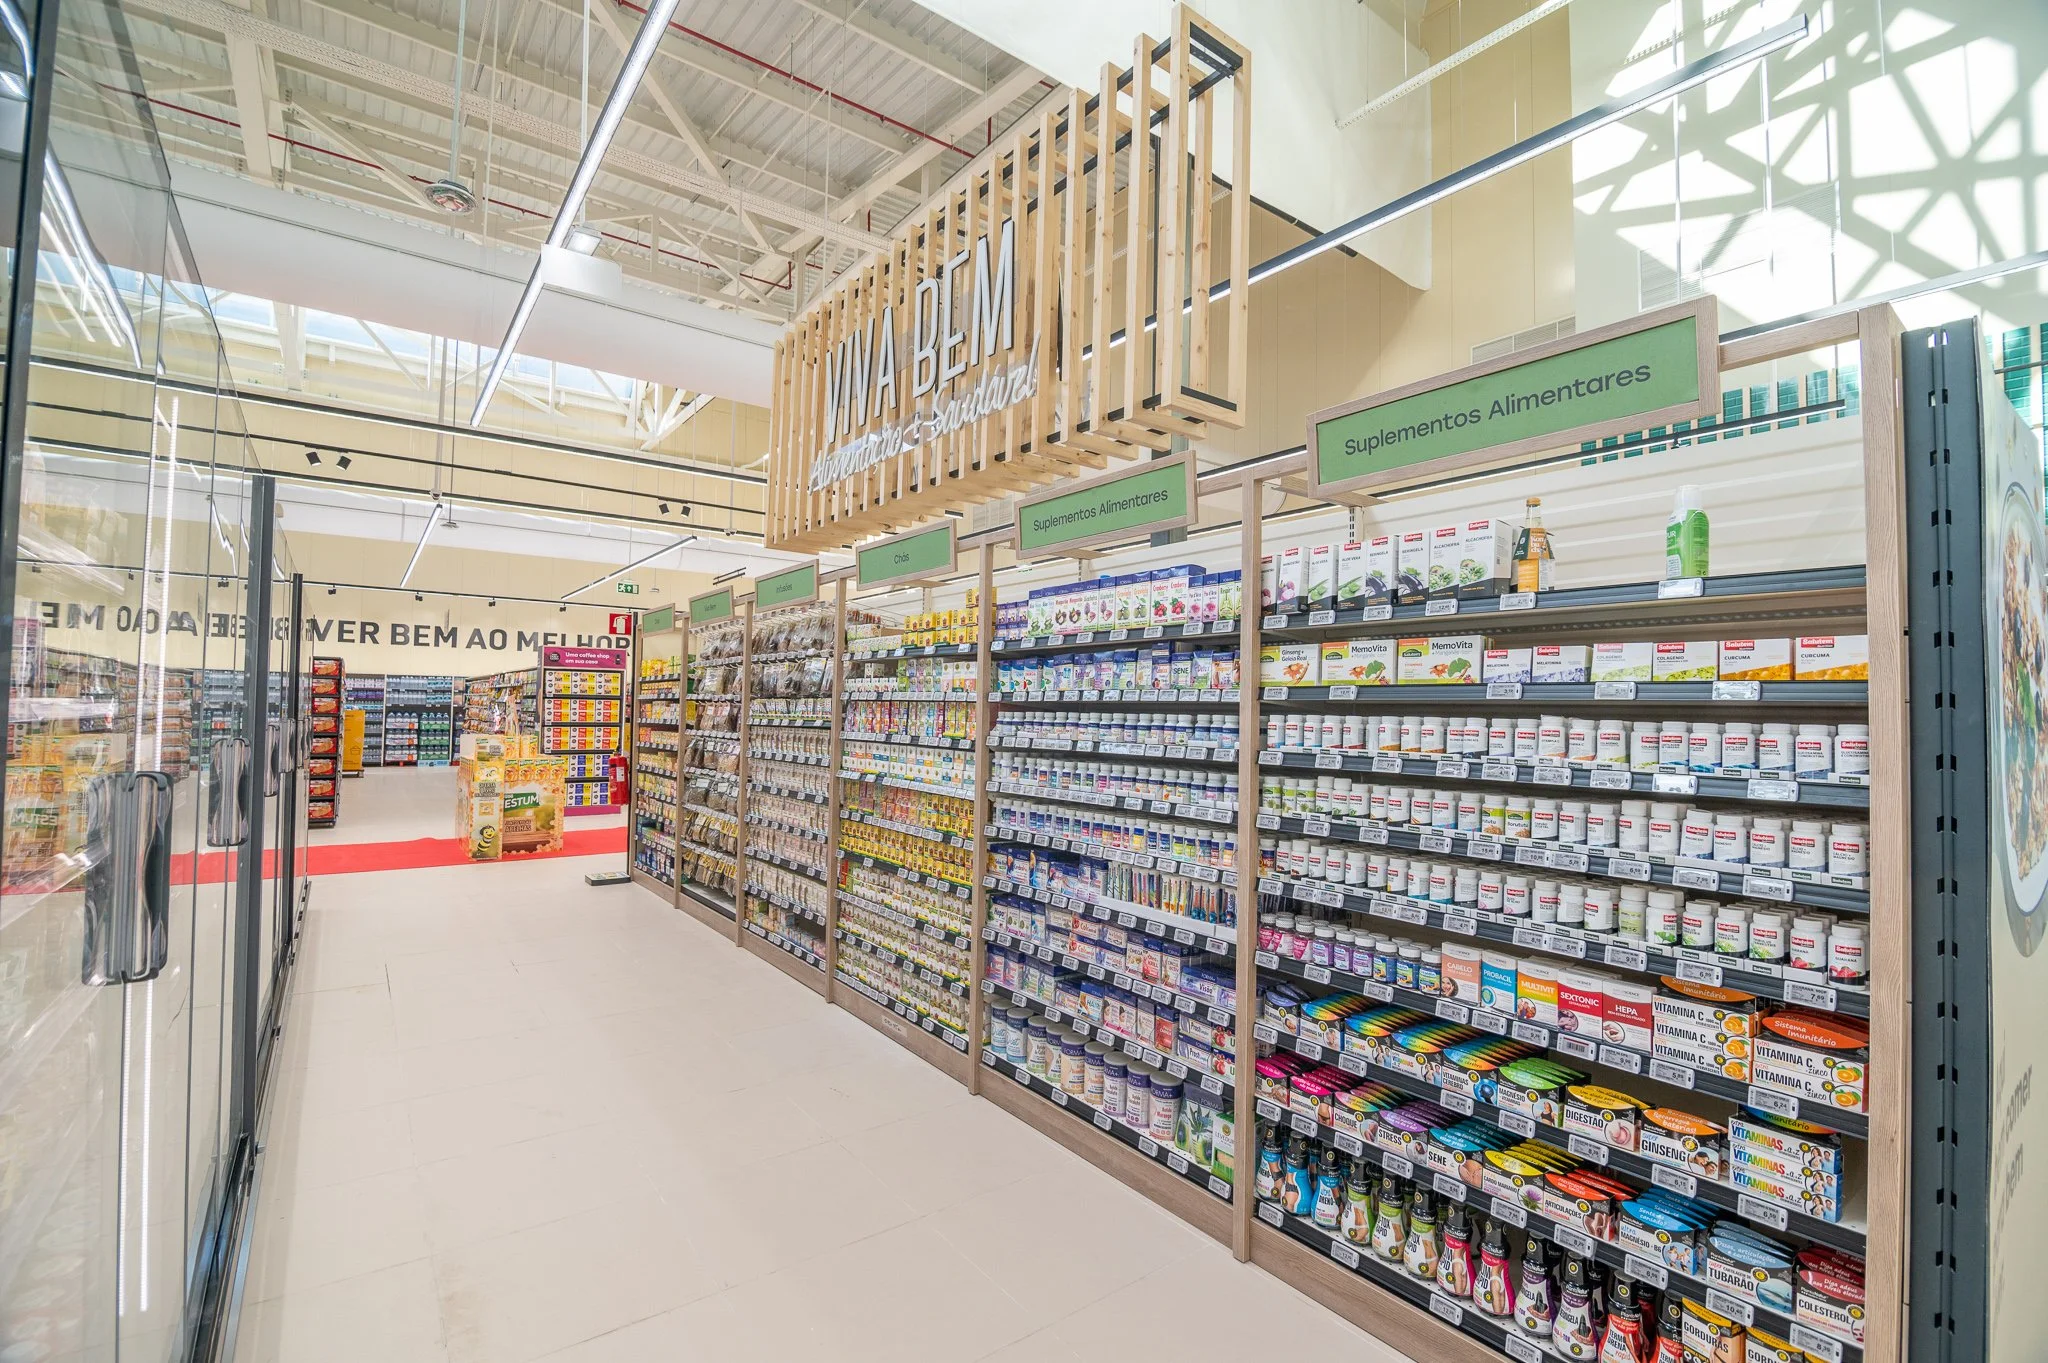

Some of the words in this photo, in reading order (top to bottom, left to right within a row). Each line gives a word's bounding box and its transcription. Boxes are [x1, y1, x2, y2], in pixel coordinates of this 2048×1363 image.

[826, 305, 897, 444] VIVA
[913, 217, 1015, 399] BEM
[928, 330, 1041, 442] Saudável
[1345, 407, 1481, 456] Suplementos
[1488, 364, 1652, 420] Alimentares
[1033, 505, 1097, 533] Suplementos
[1099, 488, 1169, 518] Alimentares
[894, 550, 910, 564] Chás
[390, 623, 459, 648] BEM
[466, 628, 508, 651] AO
[1431, 641, 1473, 650] MemoVita
[1351, 644, 1388, 653] MemoVita
[1173, 667, 1189, 675] SENE
[1446, 962, 1472, 974] CABELO
[1483, 969, 1512, 984] PROBACIL
[1521, 980, 1555, 995] MULTIVIT
[1683, 987, 1727, 1000] Imunitário
[1560, 991, 1600, 1007] SEXTONIC
[1615, 1004, 1638, 1016] HEPA
[1654, 1001, 1696, 1020] VITAMINA
[1697, 1011, 1704, 1021] C
[1656, 1023, 1698, 1042] VITAMINA
[1700, 1033, 1706, 1044] C
[1774, 1020, 1807, 1033] Sistema
[1787, 1029, 1836, 1047] Imunitário
[1655, 1043, 1697, 1064] VITAMINA
[1699, 1054, 1705, 1065] C
[1756, 1045, 1803, 1066] VITAMINA
[1755, 1068, 1802, 1089] VITAMINA
[1334, 1113, 1358, 1129] CHOQUE
[1566, 1108, 1604, 1129] DIGESTÃO
[1662, 1119, 1697, 1134] baterias!
[1763, 1111, 1809, 1131] Imunitário
[1378, 1129, 1402, 1146] STRESS
[1732, 1124, 1783, 1151] VITAMINAS
[1428, 1150, 1447, 1166] SENE
[1641, 1139, 1688, 1162] GINSENG
[1733, 1147, 1785, 1174] VITAMINAS
[1732, 1171, 1784, 1198] VITAMINAS
[1545, 1200, 1582, 1220] ARTICULAÇÕES
[1620, 1231, 1650, 1249] MAGNÉSIO
[1708, 1267, 1755, 1291] TUBARÃO
[1824, 1278, 1838, 1288] Diga
[1838, 1283, 1858, 1294] adeus
[1799, 1299, 1850, 1325] COLESTEROL
[1684, 1320, 1729, 1353] GORDURAS
